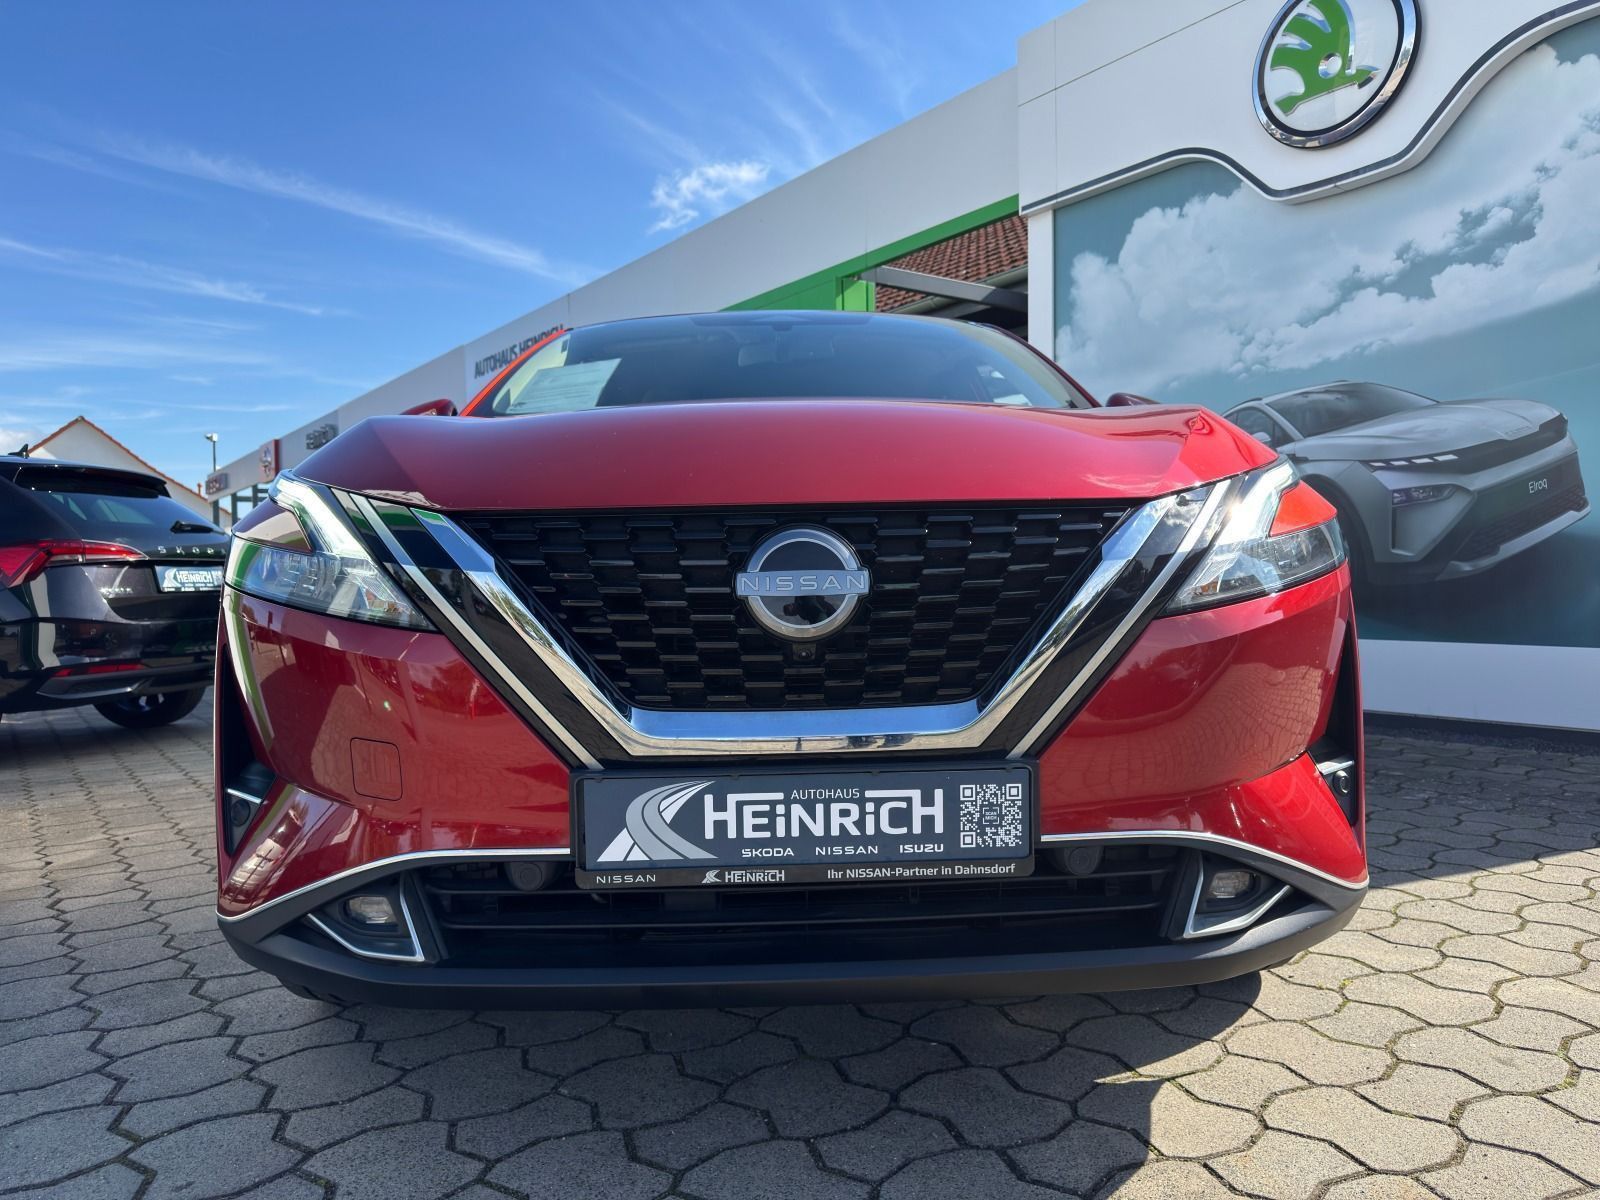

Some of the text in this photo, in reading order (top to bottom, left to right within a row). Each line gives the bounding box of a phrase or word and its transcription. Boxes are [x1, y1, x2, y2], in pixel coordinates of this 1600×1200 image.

[1528, 478, 1548, 493] Elroq
[741, 575, 865, 591] NISSAN
[790, 788, 860, 800] AUTOHAUS
[741, 843, 944, 858] SKODA NISSAN ISUZU
[827, 863, 1016, 879] Ihr NISSAN-Partner in Dahnsdorf
[596, 874, 656, 884] NISSAN
